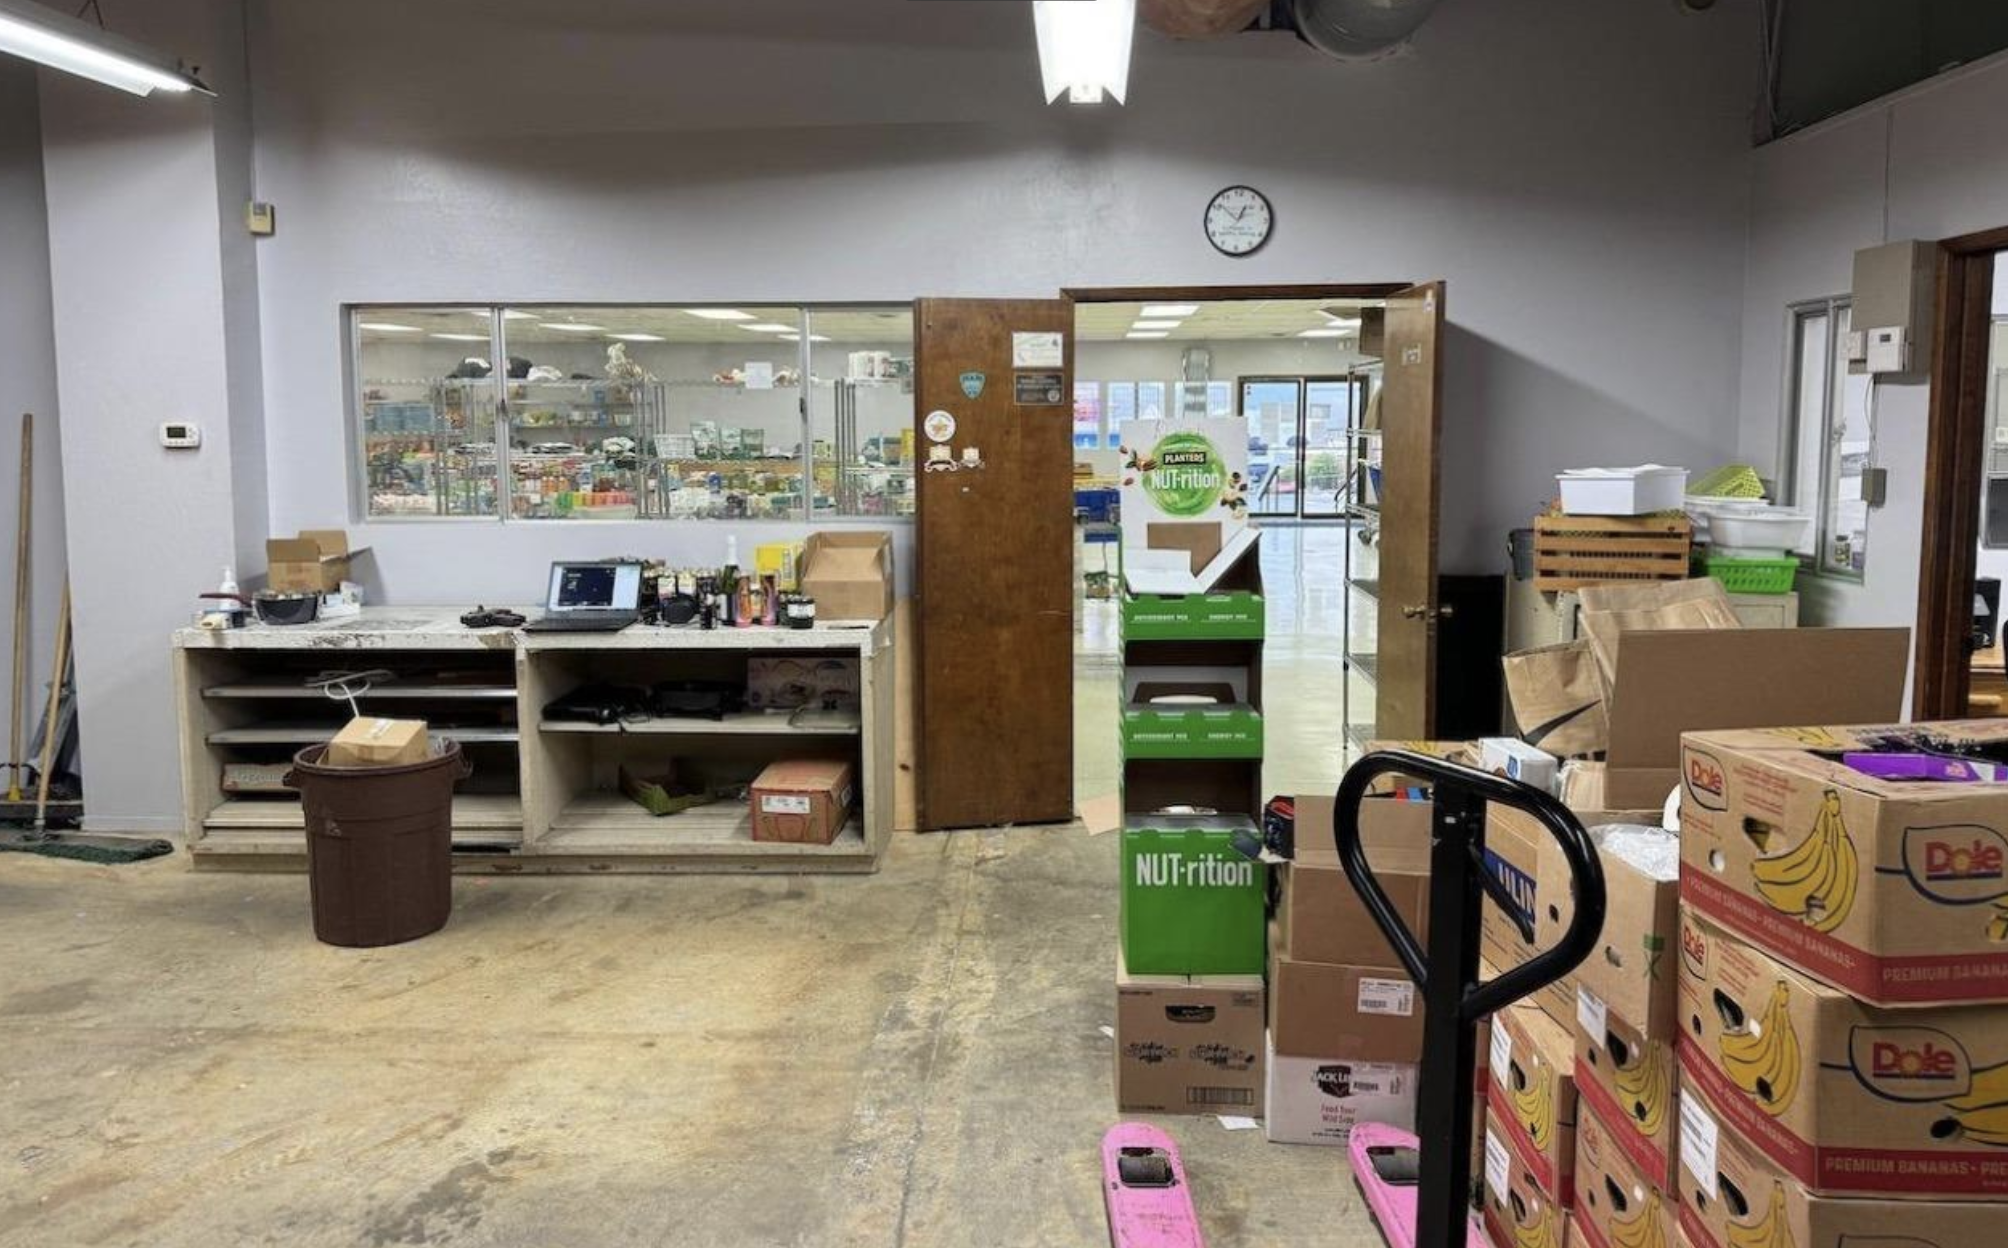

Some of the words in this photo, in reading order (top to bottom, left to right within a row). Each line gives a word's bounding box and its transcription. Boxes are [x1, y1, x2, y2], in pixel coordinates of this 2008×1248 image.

[1164, 453, 1205, 464] PLANTERS
[1691, 758, 1722, 790] Dole
[1925, 839, 2003, 876] Dole
[1872, 1042, 1957, 1077] Dole
[1825, 1156, 1895, 1174] PREMIUM
[1898, 1160, 1970, 1175] BANANAS
